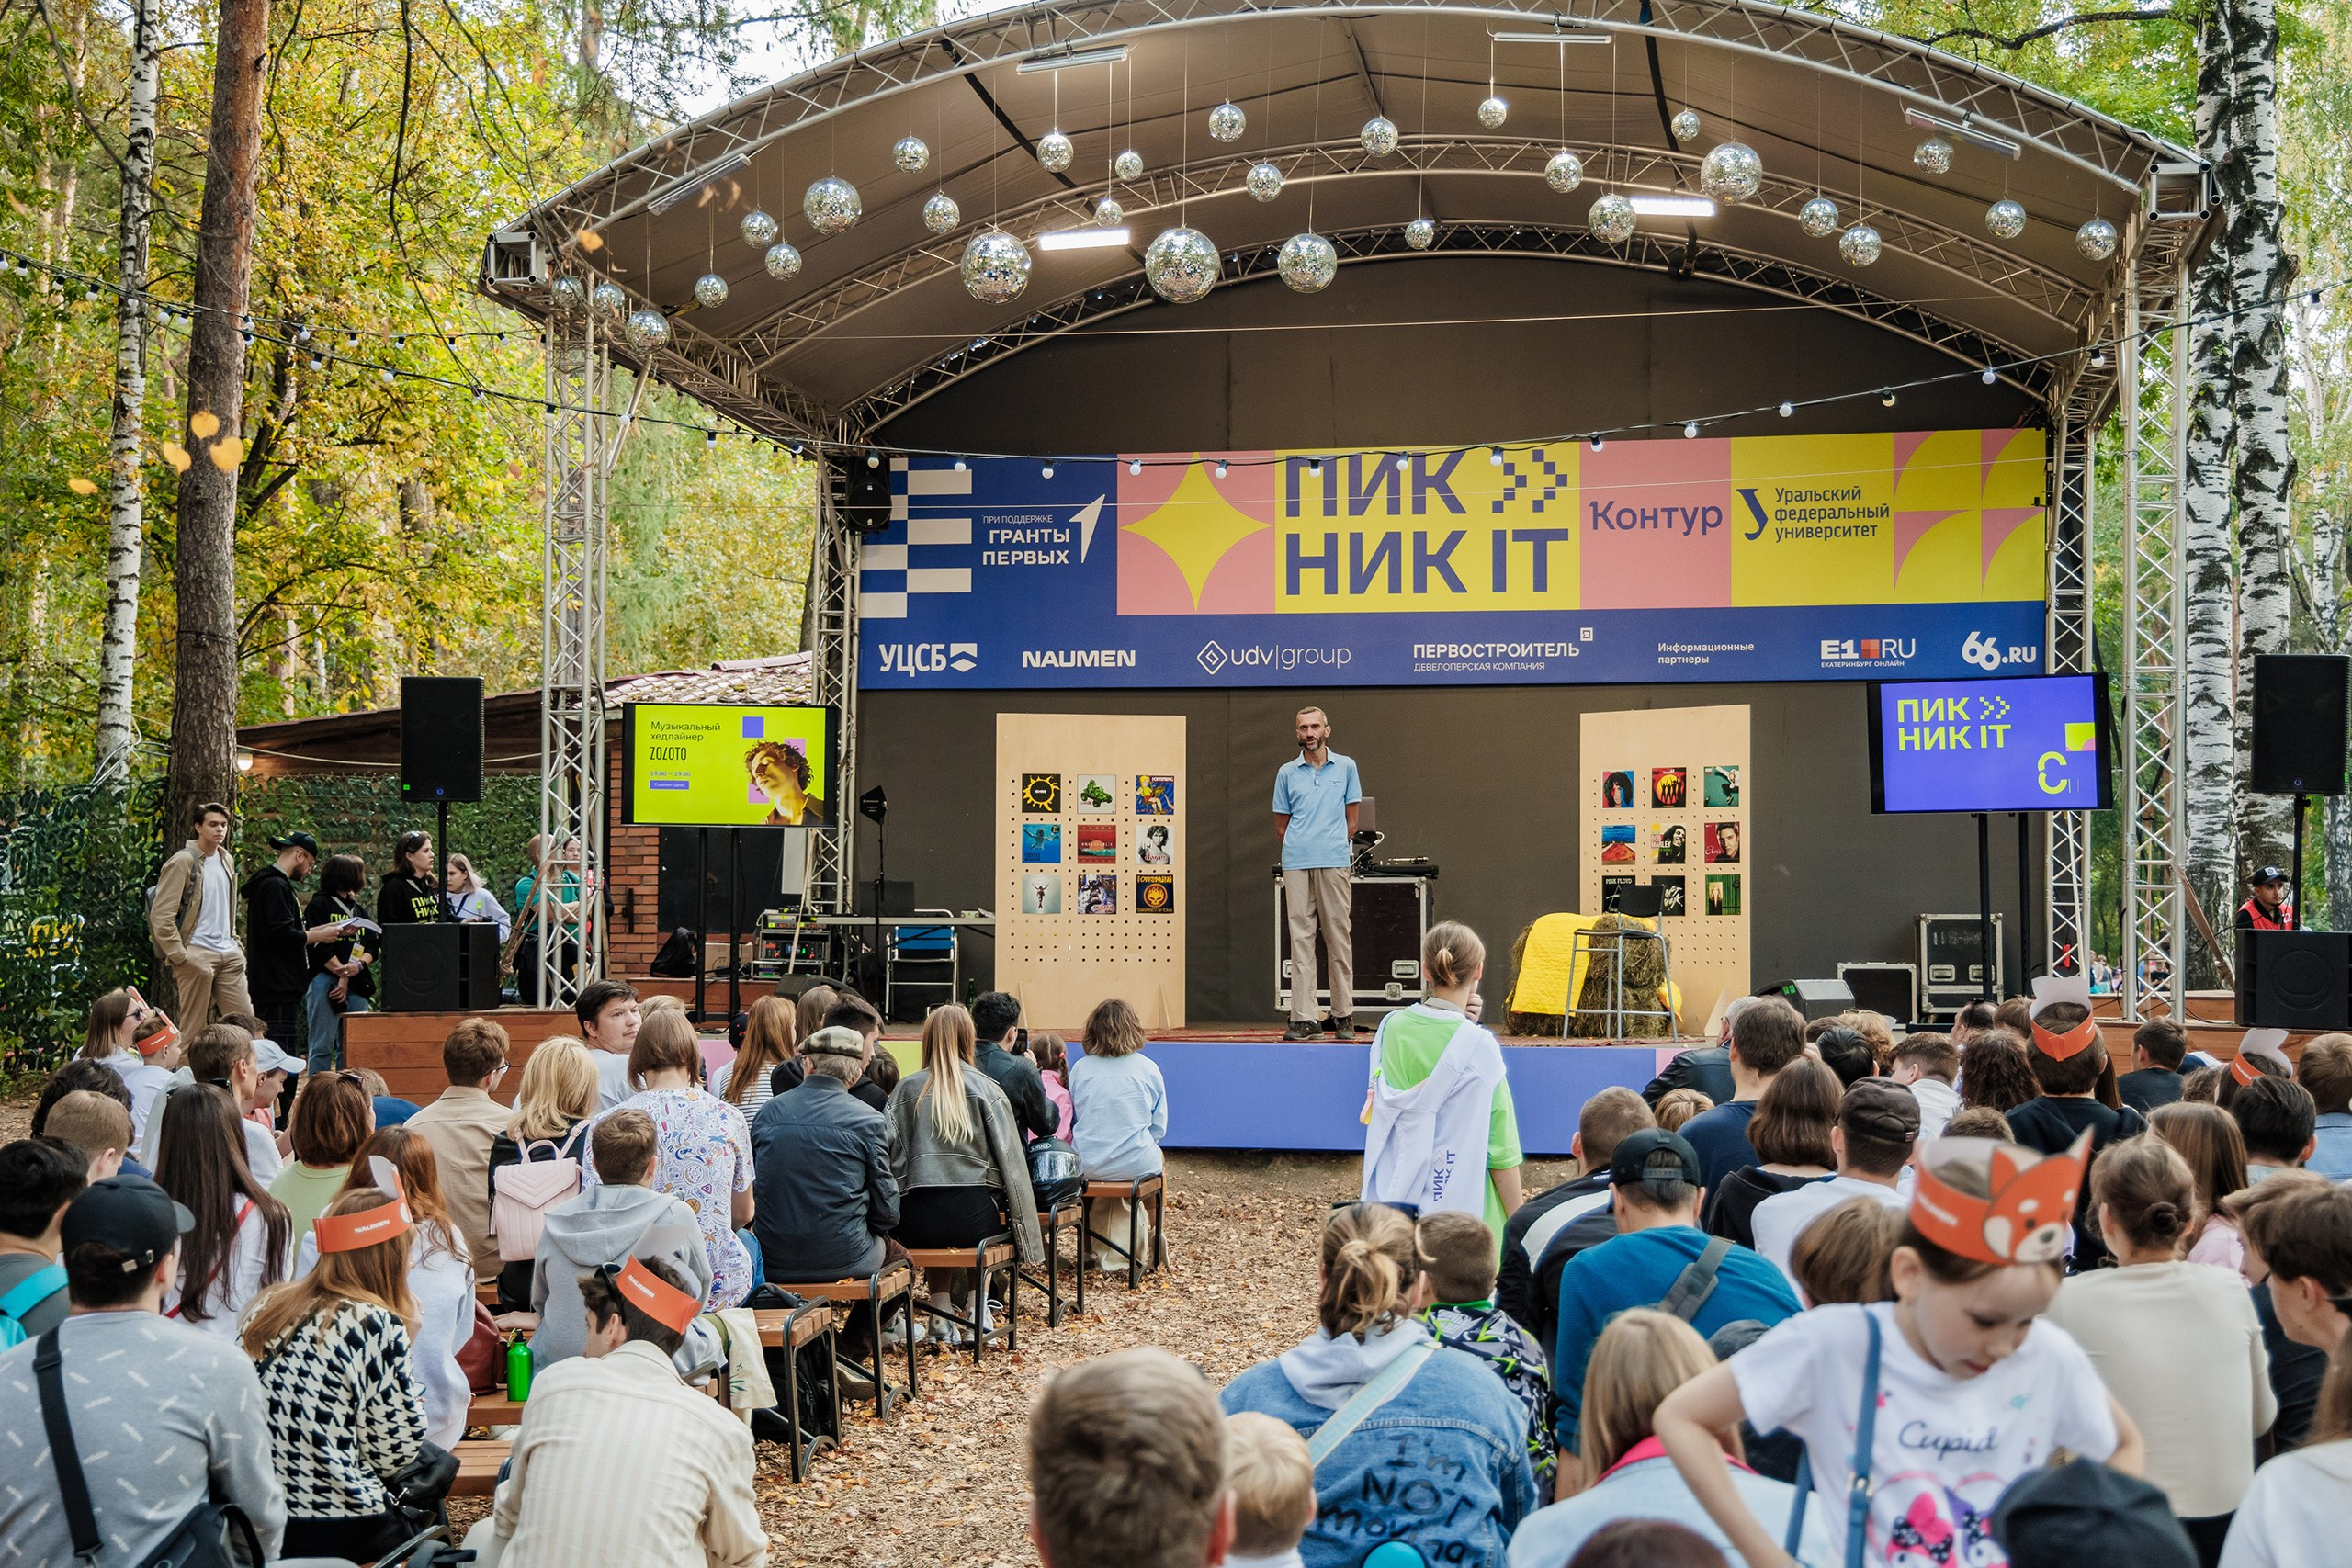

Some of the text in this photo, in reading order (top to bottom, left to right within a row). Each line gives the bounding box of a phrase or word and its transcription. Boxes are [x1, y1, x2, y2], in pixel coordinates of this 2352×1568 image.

[1286, 451, 1467, 517] ПИК
[1774, 485, 1861, 505] Уральский
[982, 513, 1053, 525] ПРИ ПОДДЕРЖКЕ
[1589, 500, 1724, 537] Контур
[1774, 502, 1891, 525] федеральный
[989, 527, 1070, 545] ГРАНТЫ
[1774, 525, 1879, 544] университет
[982, 549, 1069, 566] ПЕРВЫХ
[1286, 528, 1569, 595] НИК IT
[1413, 642, 1580, 659] ПЕРВОСТРОИТЕЛЬ
[1657, 642, 1755, 654] Информационные
[1820, 639, 1860, 660] E1
[1961, 631, 2037, 671] 66.RU
[878, 642, 947, 678] УЦСБ
[1022, 649, 1136, 669] NAUMEN
[1413, 661, 1545, 672] ДЕВЕЛОПЕРСКАЯ КОМПАНИЯ
[1657, 655, 1709, 665] партнеры
[1873, 659, 1905, 667] ОНЛАЙН
[1897, 696, 1971, 723] ПИК
[650, 720, 721, 732] Музыкальный
[650, 732, 704, 743] хедлайнер
[1898, 724, 2012, 750] НИК IT
[1898, 1419, 1998, 1461] Cupid
